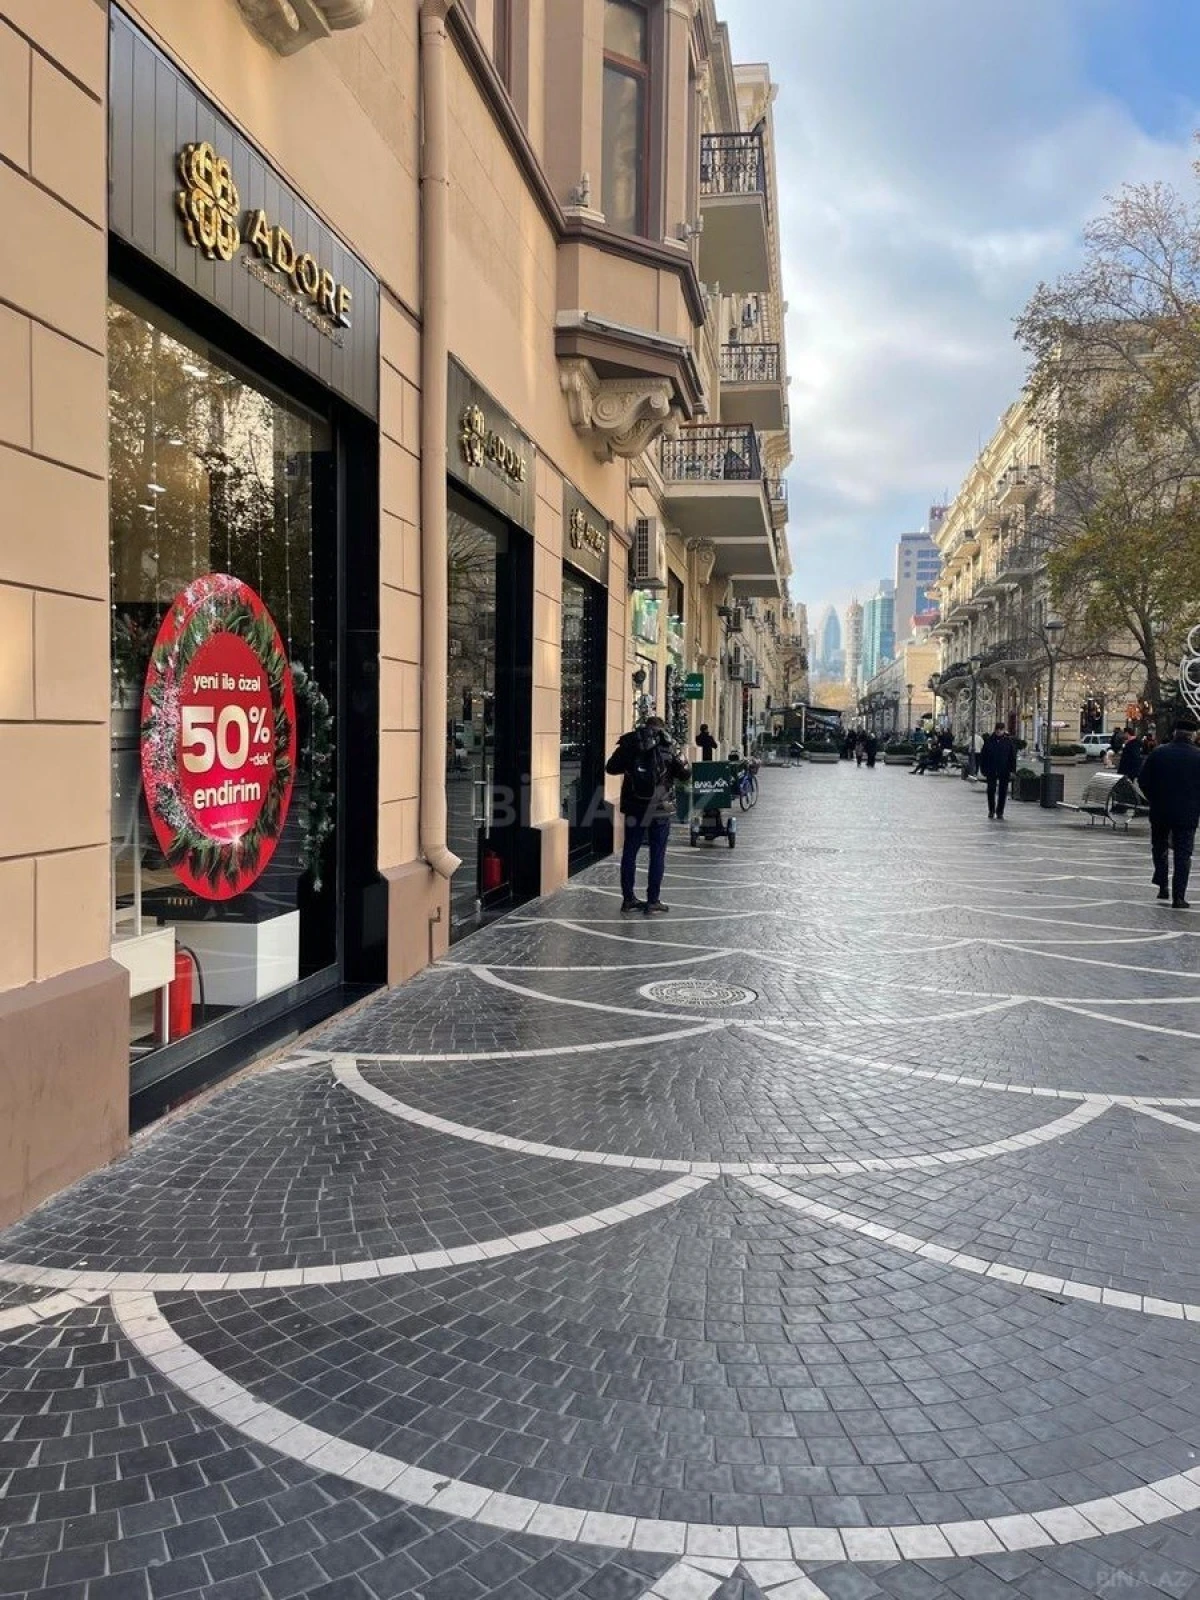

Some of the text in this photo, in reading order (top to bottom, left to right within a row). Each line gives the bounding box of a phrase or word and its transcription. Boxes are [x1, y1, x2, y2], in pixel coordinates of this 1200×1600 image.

[246, 209, 353, 329] ADORE
[193, 672, 219, 694] yeni
[182, 704, 271, 774] 50%
[193, 778, 261, 809] endirim
